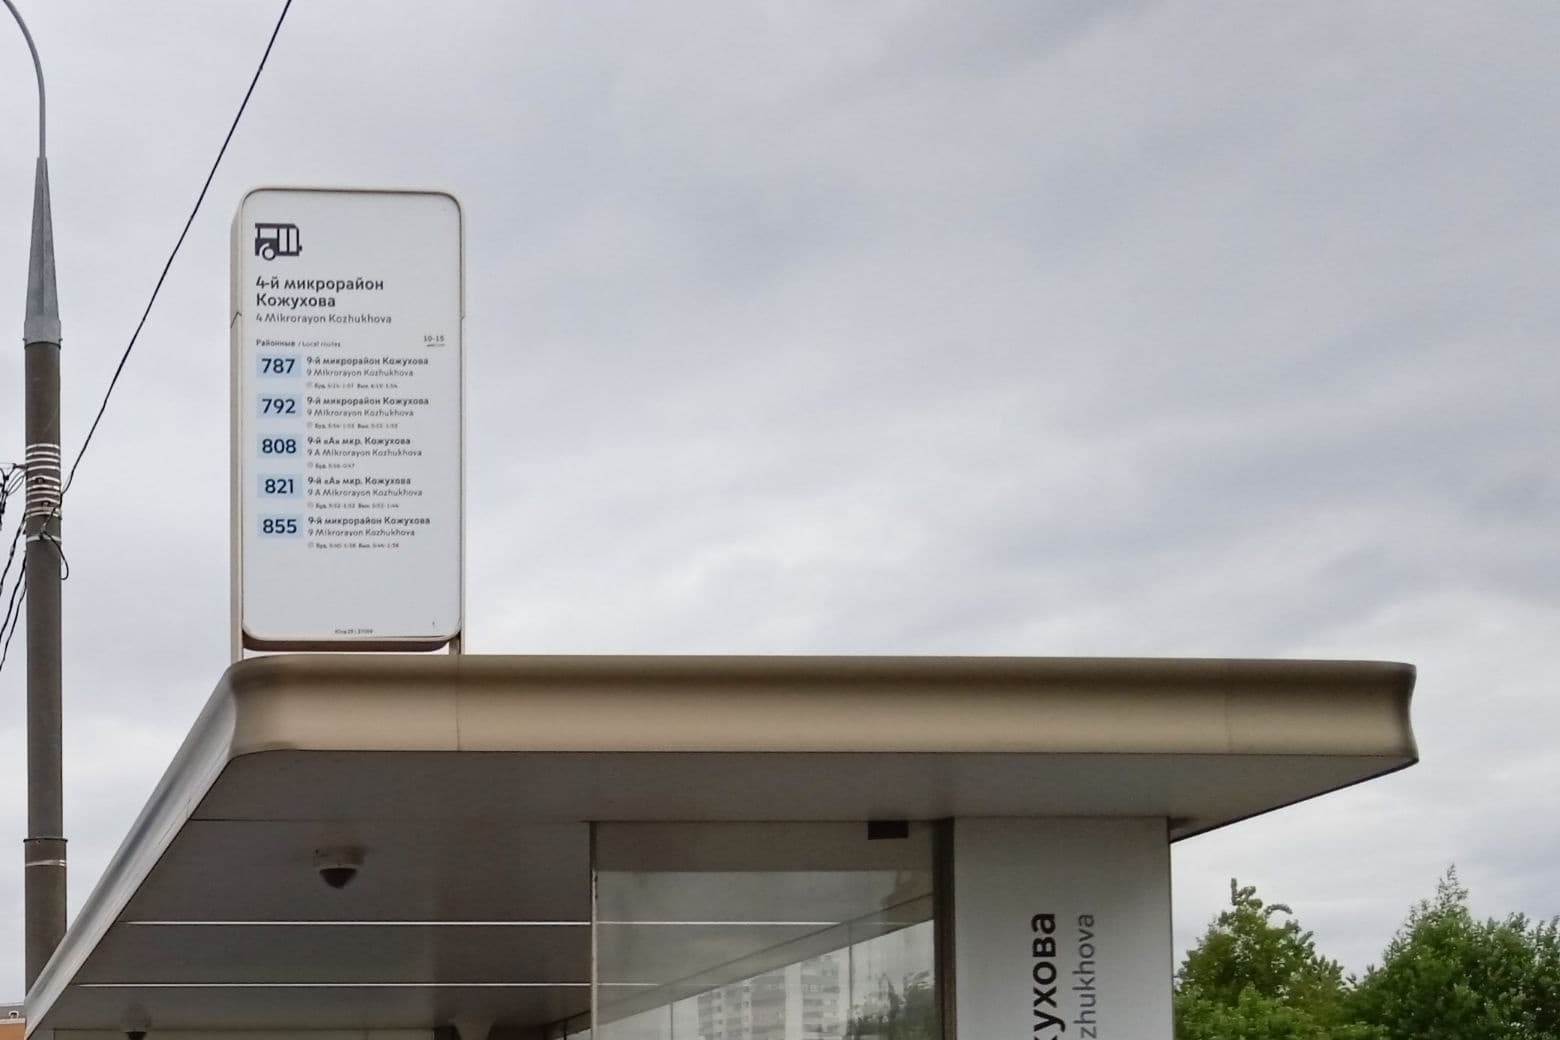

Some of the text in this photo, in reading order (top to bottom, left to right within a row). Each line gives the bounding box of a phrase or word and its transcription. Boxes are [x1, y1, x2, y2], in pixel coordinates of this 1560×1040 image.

[256, 276, 384, 293] 4-й микрорайон
[256, 293, 336, 309] Кожухова
[256, 313, 392, 324] 4 Mikrorayon Kozhukhova
[262, 358, 295, 373] 787
[323, 357, 380, 367] микрорайон
[382, 356, 429, 367] Кожухова
[313, 369, 361, 377] Mikrorayon
[364, 369, 413, 377] Kozhukhova
[262, 398, 296, 414] 792
[323, 397, 380, 407] микрорайон
[383, 396, 429, 407] Кожухова
[314, 409, 362, 417] Mikrorayon
[364, 409, 414, 417] Kozhukhova
[262, 439, 296, 454] 808
[364, 436, 411, 447] Кожухова
[322, 449, 370, 458] Mikrorayon
[372, 448, 422, 457] Kozhukhova
[265, 479, 293, 494] 821
[365, 476, 411, 487] Кожухова
[322, 489, 371, 498] Mikrorayon
[373, 488, 423, 497] Kozhukhova
[262, 519, 297, 534] 855
[324, 517, 382, 527] микрорайон
[384, 516, 431, 527] Кожухова
[315, 529, 363, 538] Mikrorayon
[365, 528, 415, 537] Kozhukhova
